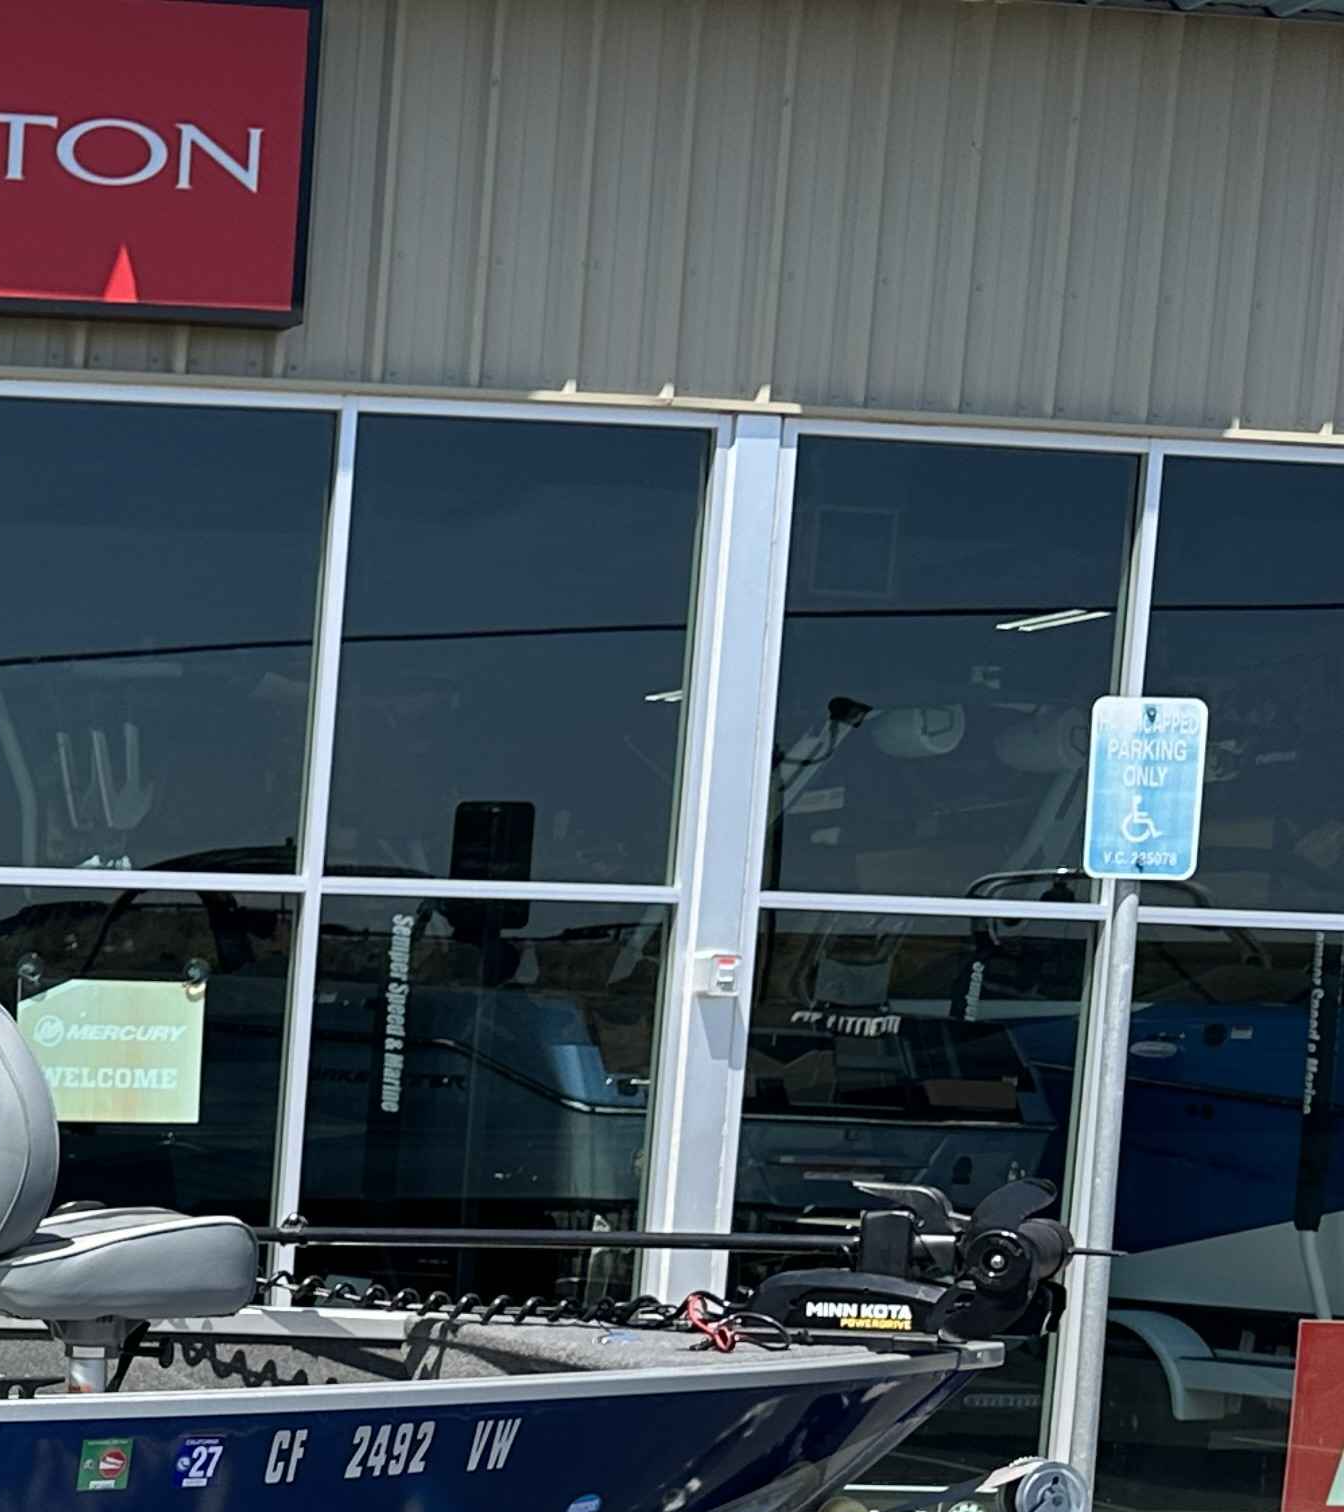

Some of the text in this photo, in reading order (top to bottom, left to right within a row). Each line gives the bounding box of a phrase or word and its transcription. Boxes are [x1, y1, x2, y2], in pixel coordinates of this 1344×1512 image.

[1107, 738, 1188, 761] PARKING
[1123, 764, 1168, 787] ONLY
[388, 913, 414, 981] Semper
[67, 1024, 187, 1041] MERCURY
[42, 1066, 178, 1089] WELCOME
[805, 1301, 912, 1320] MINN KOTA
[188, 1445, 224, 1478] 27
[264, 1417, 523, 1484] CF 2492 VW
